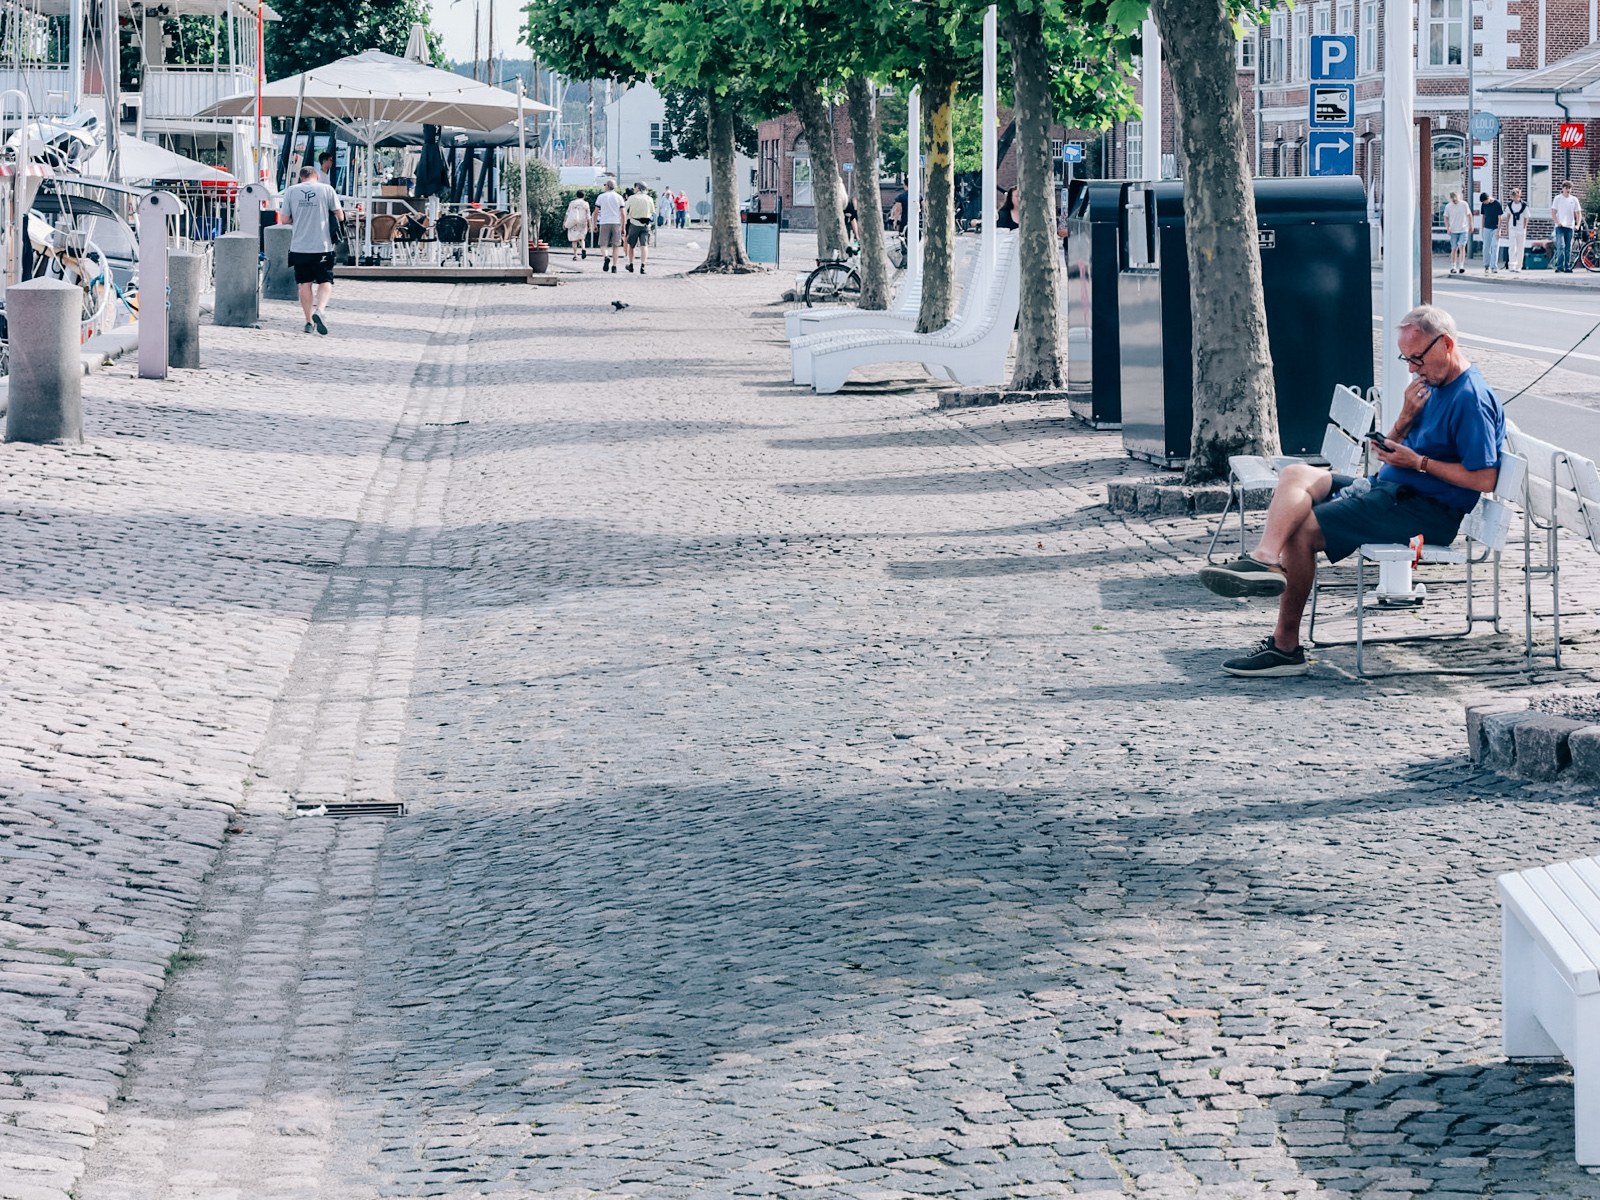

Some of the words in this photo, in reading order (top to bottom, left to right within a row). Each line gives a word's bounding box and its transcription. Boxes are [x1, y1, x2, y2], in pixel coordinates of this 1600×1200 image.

[1322, 40, 1348, 76] P
[1475, 118, 1495, 129] LOLO
[1562, 126, 1583, 146] illy
